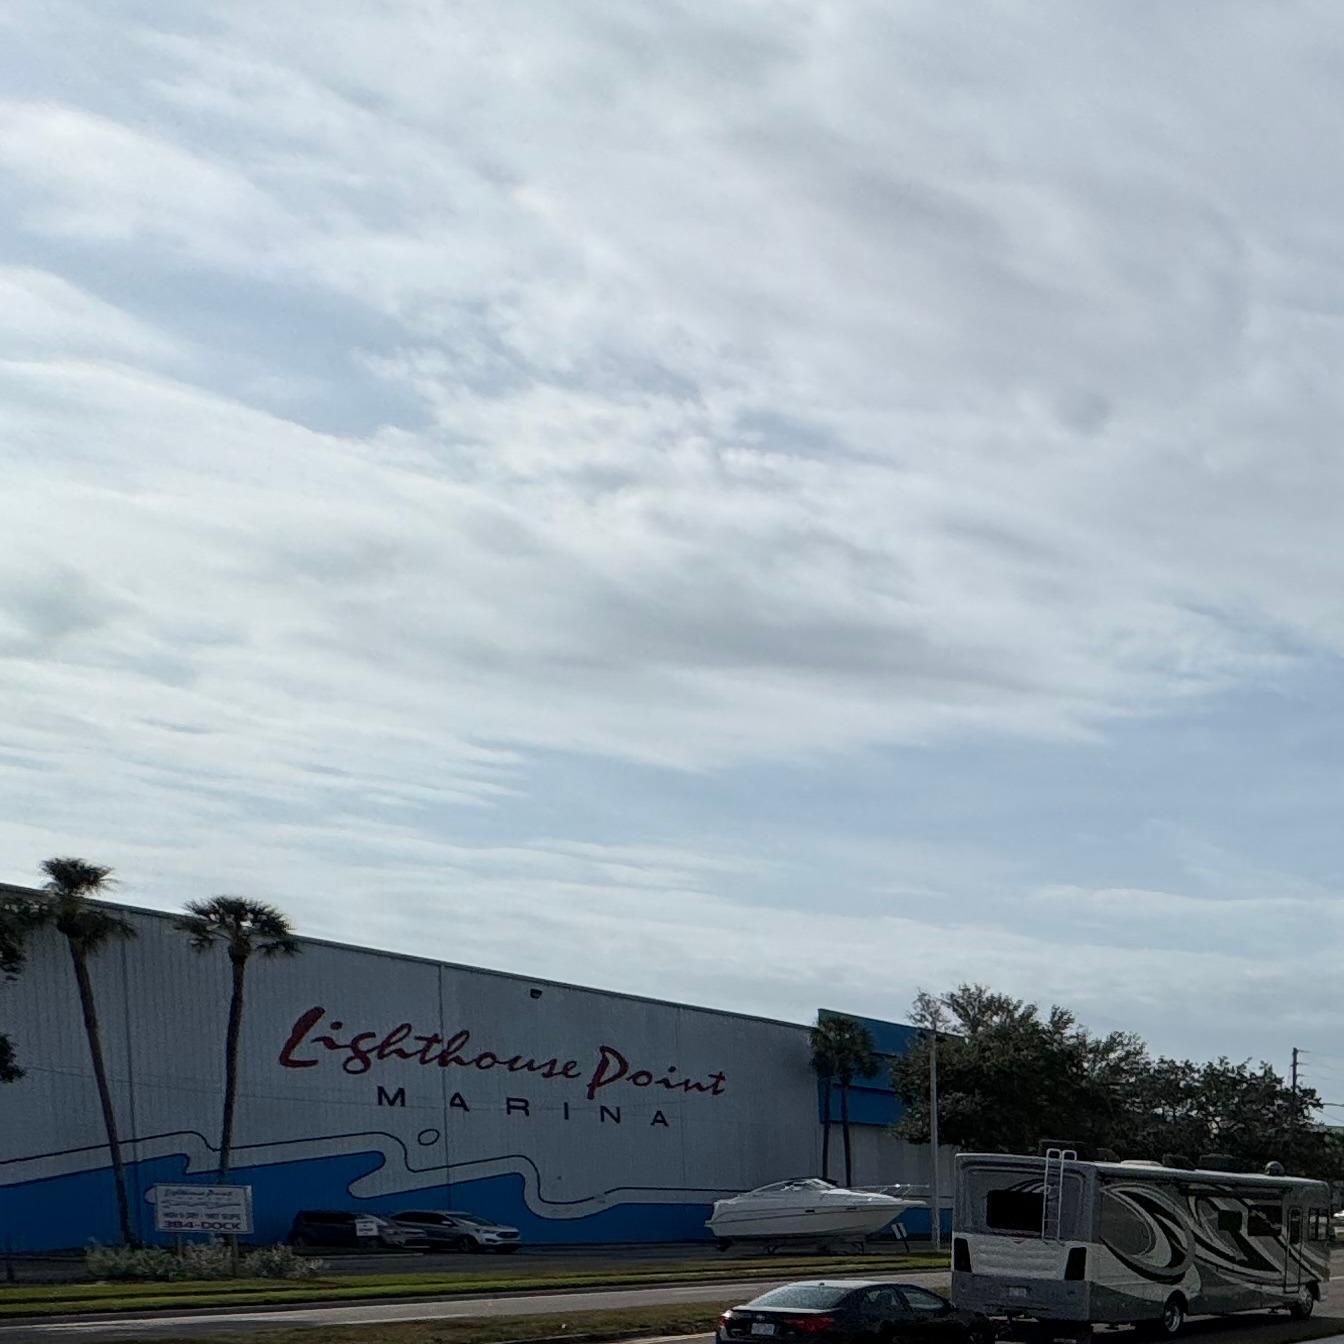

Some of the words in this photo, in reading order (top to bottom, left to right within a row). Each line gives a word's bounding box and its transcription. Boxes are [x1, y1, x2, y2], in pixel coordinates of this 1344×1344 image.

[279, 1006, 582, 1075] Lighthouse
[587, 1045, 727, 1100] Point
[376, 1085, 670, 1128] MARINA
